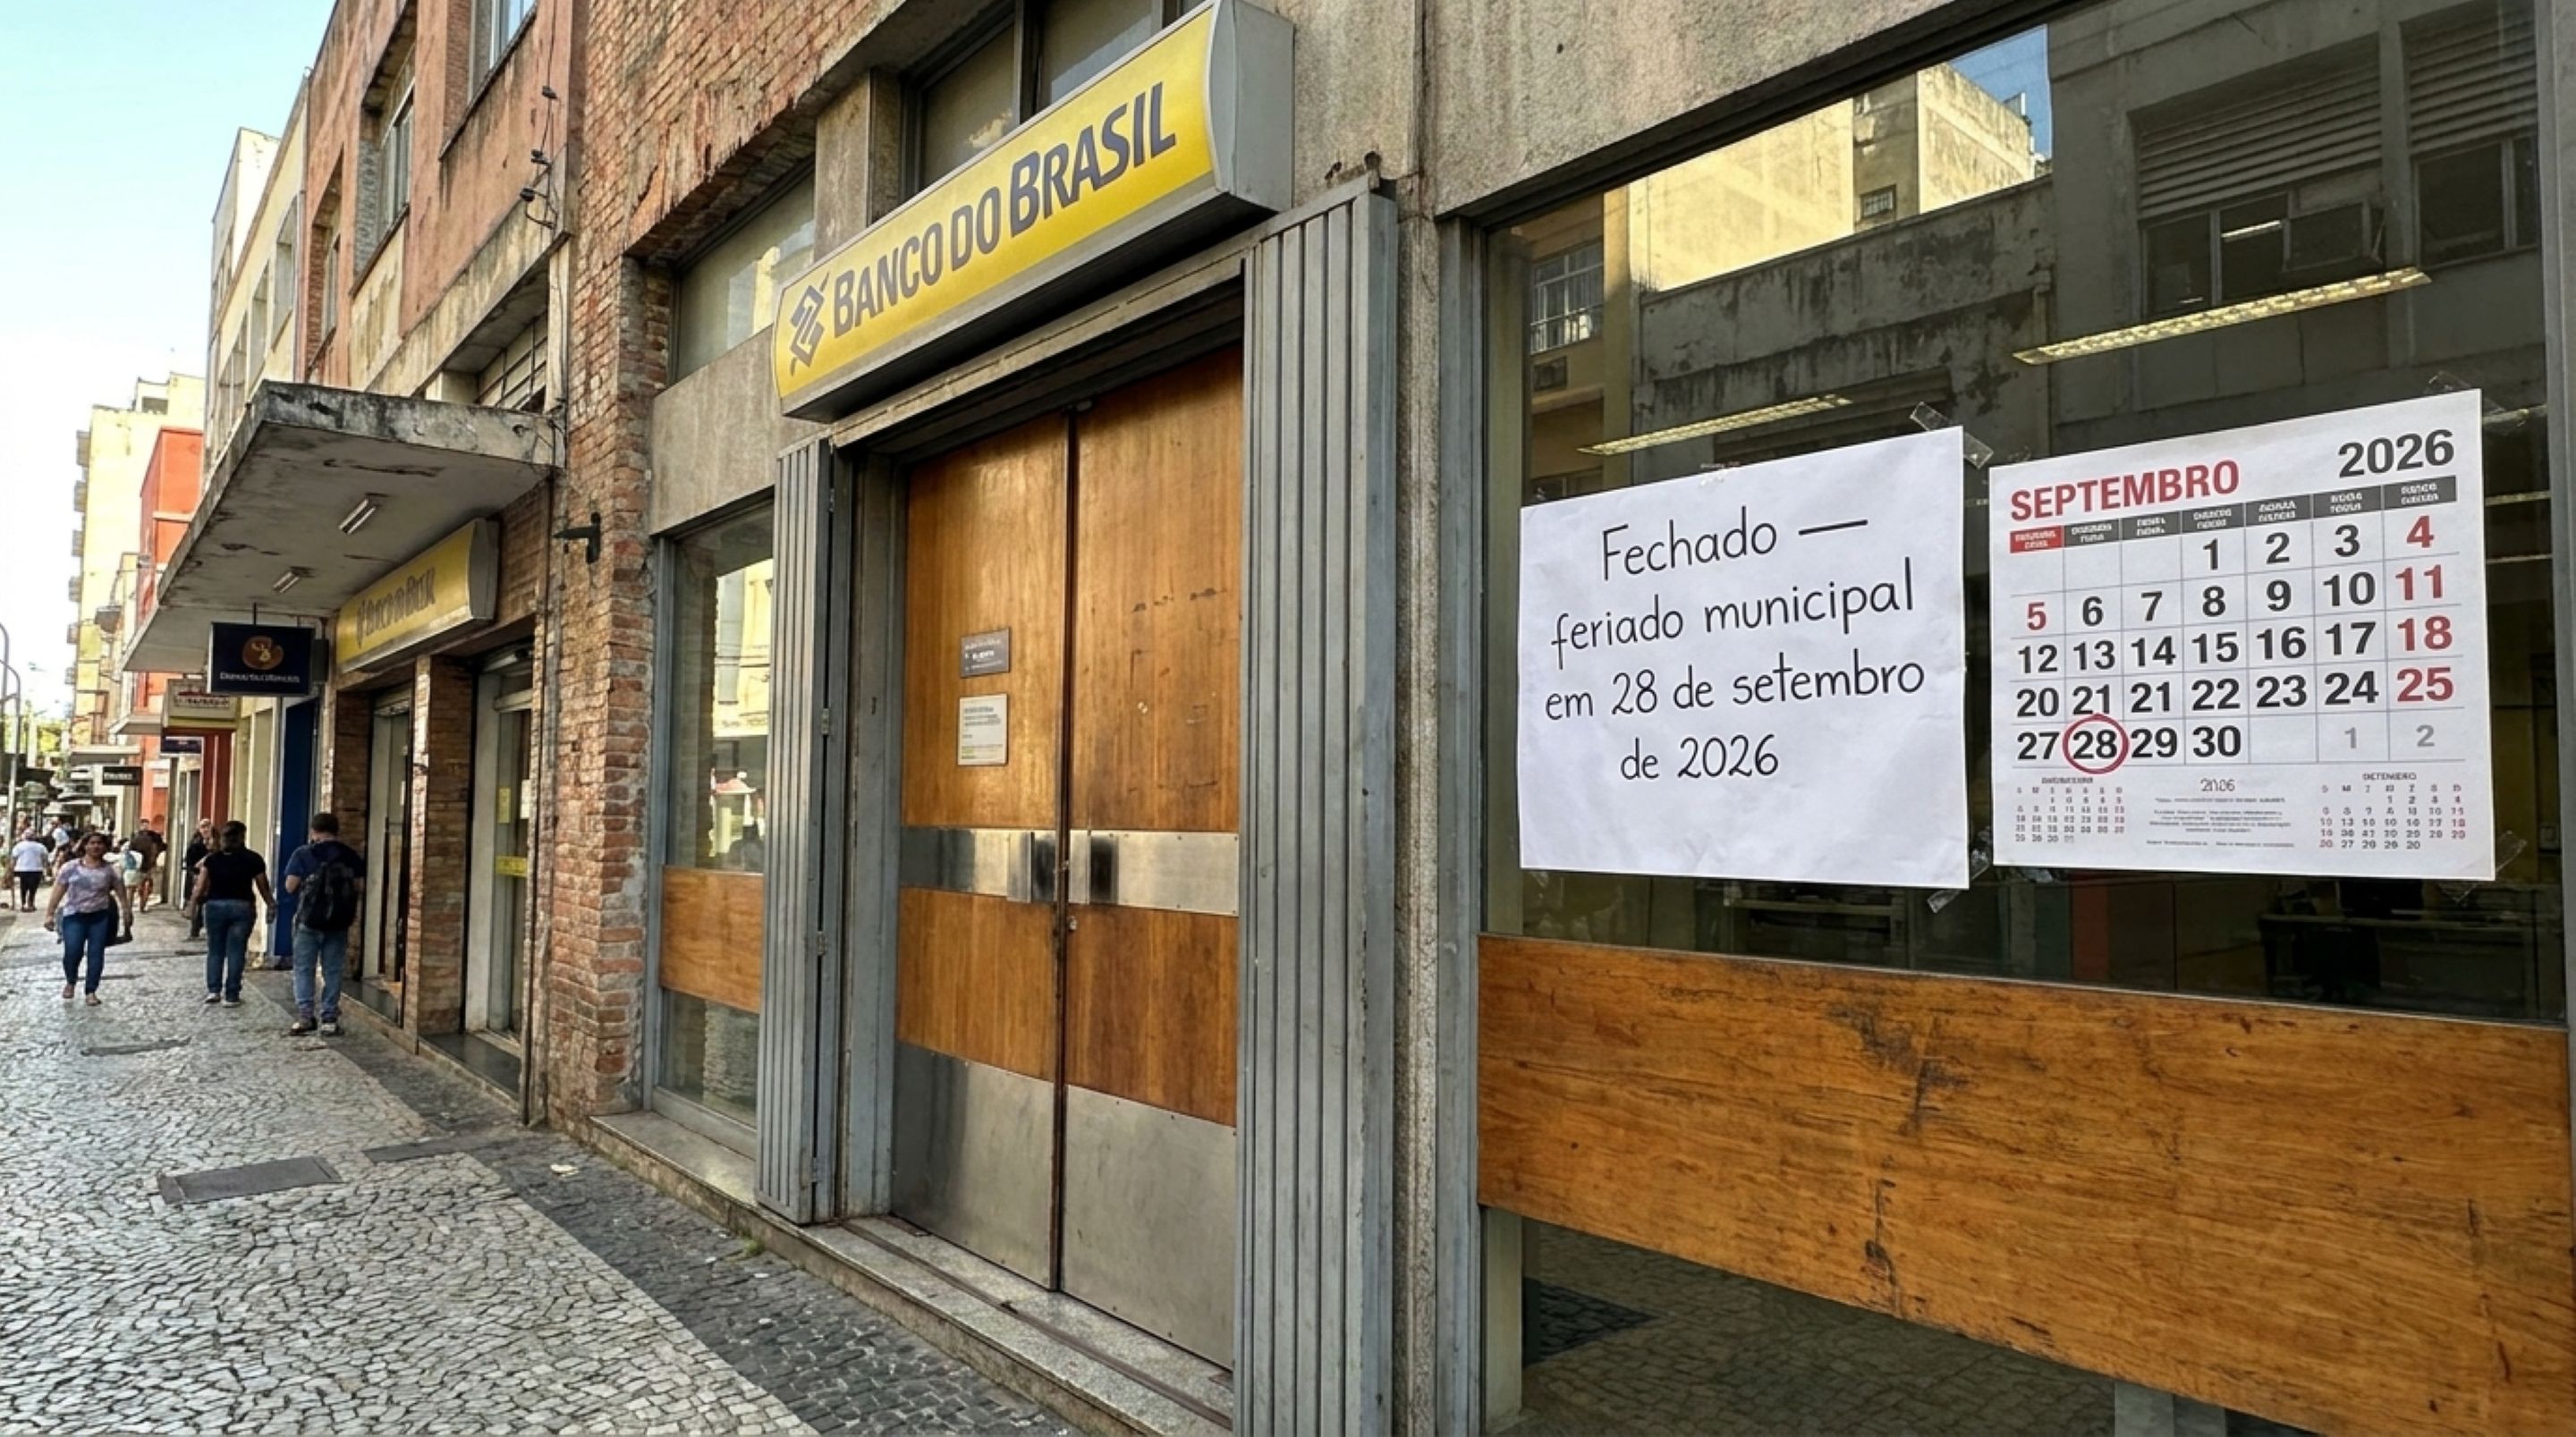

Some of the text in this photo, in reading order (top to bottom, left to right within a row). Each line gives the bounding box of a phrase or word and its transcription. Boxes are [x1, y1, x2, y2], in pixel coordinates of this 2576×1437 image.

[833, 81, 1176, 337] BANCO DO BRASIL
[2338, 429, 2454, 478] 2026
[2011, 459, 2240, 521] SEPTEMBRO
[1602, 505, 1777, 581] Fechado
[2203, 515, 2435, 571] 1 2 3 4
[1551, 556, 1914, 670] feriado municipal
[2027, 564, 2443, 631] 5 6 7 8 9 10 11
[2018, 615, 2453, 674] 12 13 14 15 16 17 18
[1545, 647, 1925, 721] em 28 de setembro
[2016, 666, 2453, 718] 20 21 21 22 23 24 25
[1620, 733, 1779, 781] de 2026
[2017, 724, 2436, 760] 27 28 29 30 1 2
